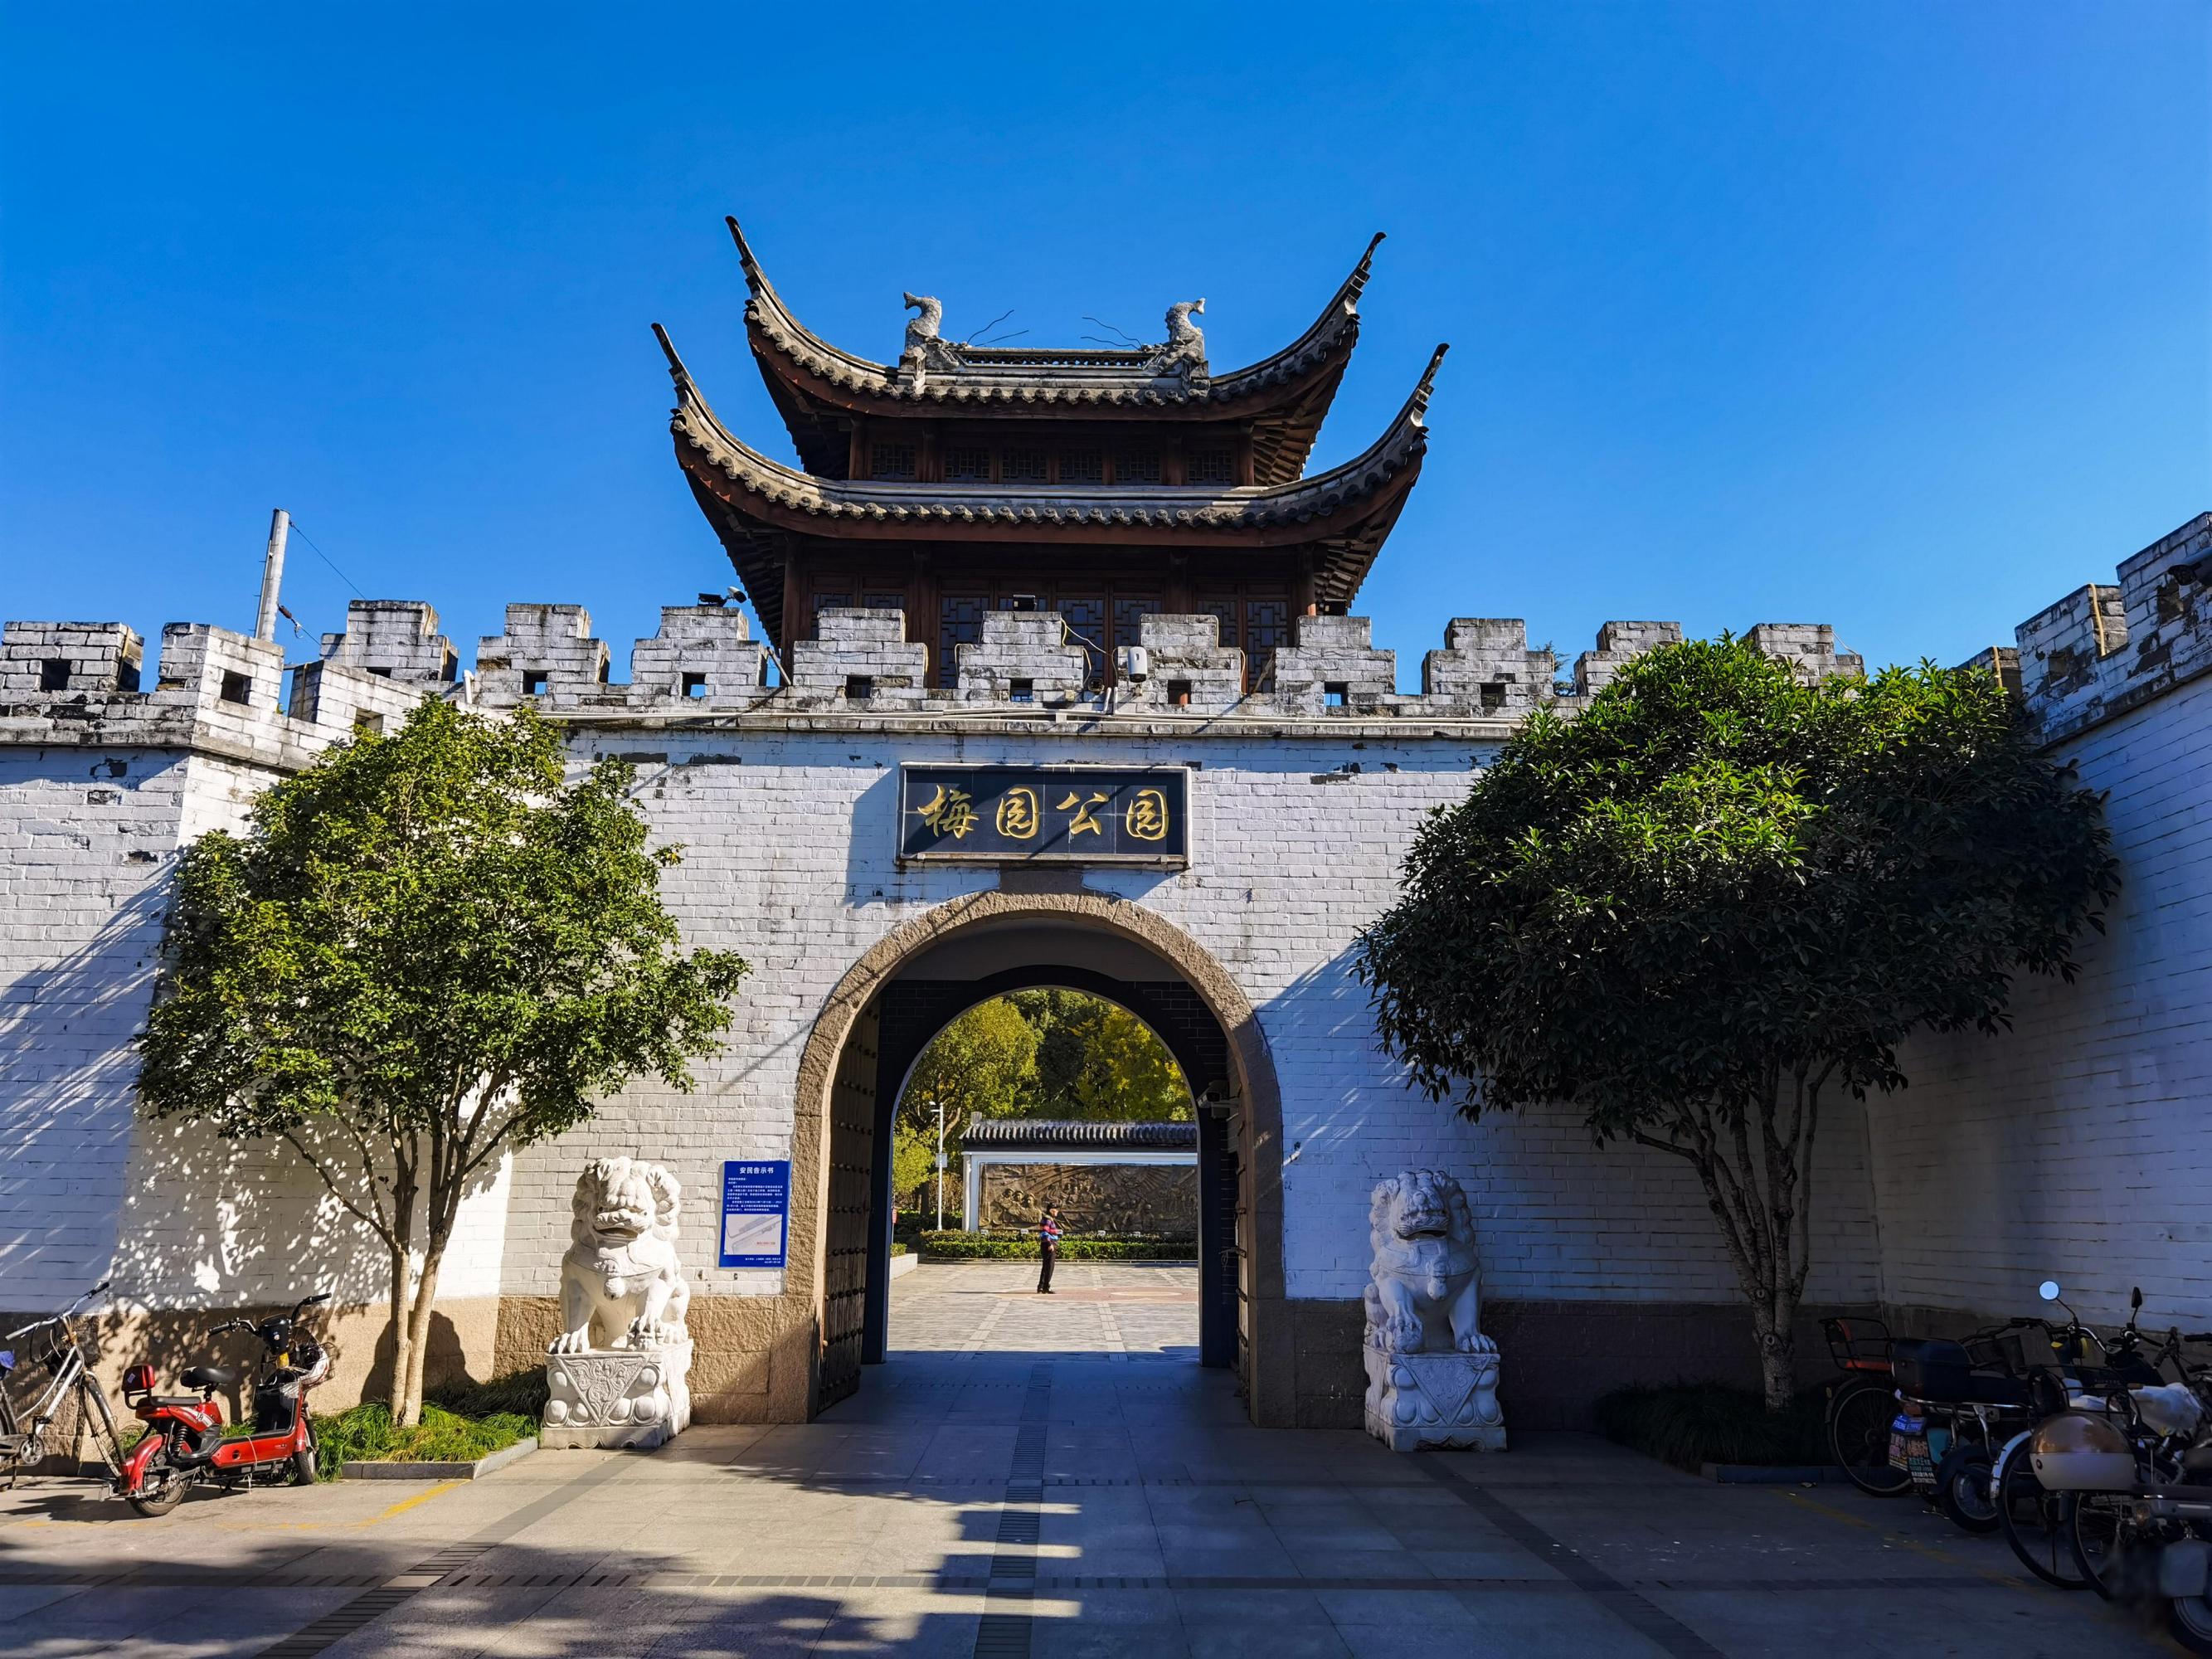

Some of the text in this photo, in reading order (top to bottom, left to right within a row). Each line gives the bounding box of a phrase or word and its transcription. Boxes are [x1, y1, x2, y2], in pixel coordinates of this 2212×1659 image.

[916, 784, 1169, 841] 梅园公园
[739, 1166, 774, 1175] 安民告示书
